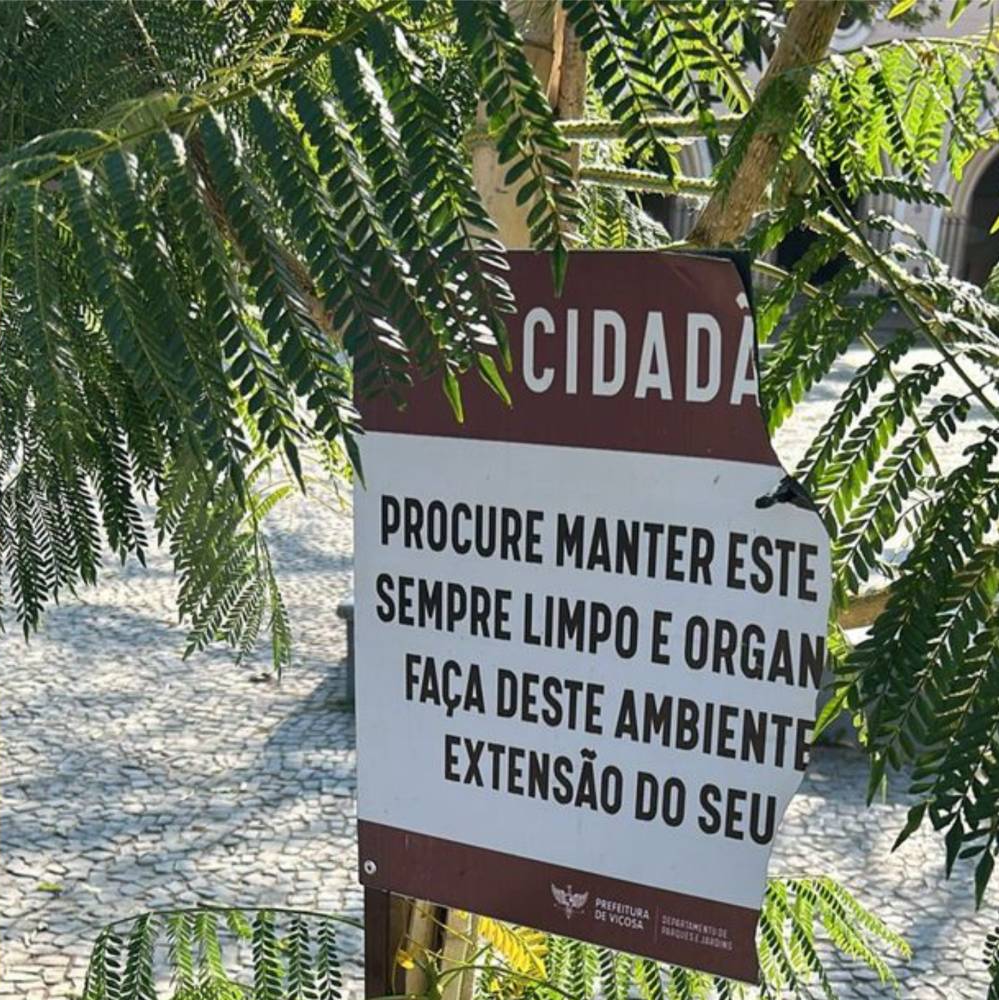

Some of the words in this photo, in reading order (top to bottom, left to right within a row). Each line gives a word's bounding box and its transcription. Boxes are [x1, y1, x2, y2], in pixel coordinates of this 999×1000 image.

[381, 494, 544, 564] PROCURE
[556, 513, 715, 585] MANTER
[726, 532, 819, 602] ESTE
[376, 573, 512, 640] SEMPRE
[523, 593, 639, 660] LIMPO
[651, 611, 672, 665] E
[684, 615, 825, 690] ORGAN
[405, 653, 486, 717] FAÇA
[496, 668, 605, 736] DESTE
[614, 689, 816, 771] AMBIENTE
[444, 734, 623, 815] EXTENSÃO
[634, 771, 687, 828] DO
[698, 783, 778, 845] SEU
[594, 897, 650, 920] PREFEITURA
[594, 909, 607, 921] DE
[609, 912, 645, 930] VIÇOSA
[717, 928, 728, 939] DE
